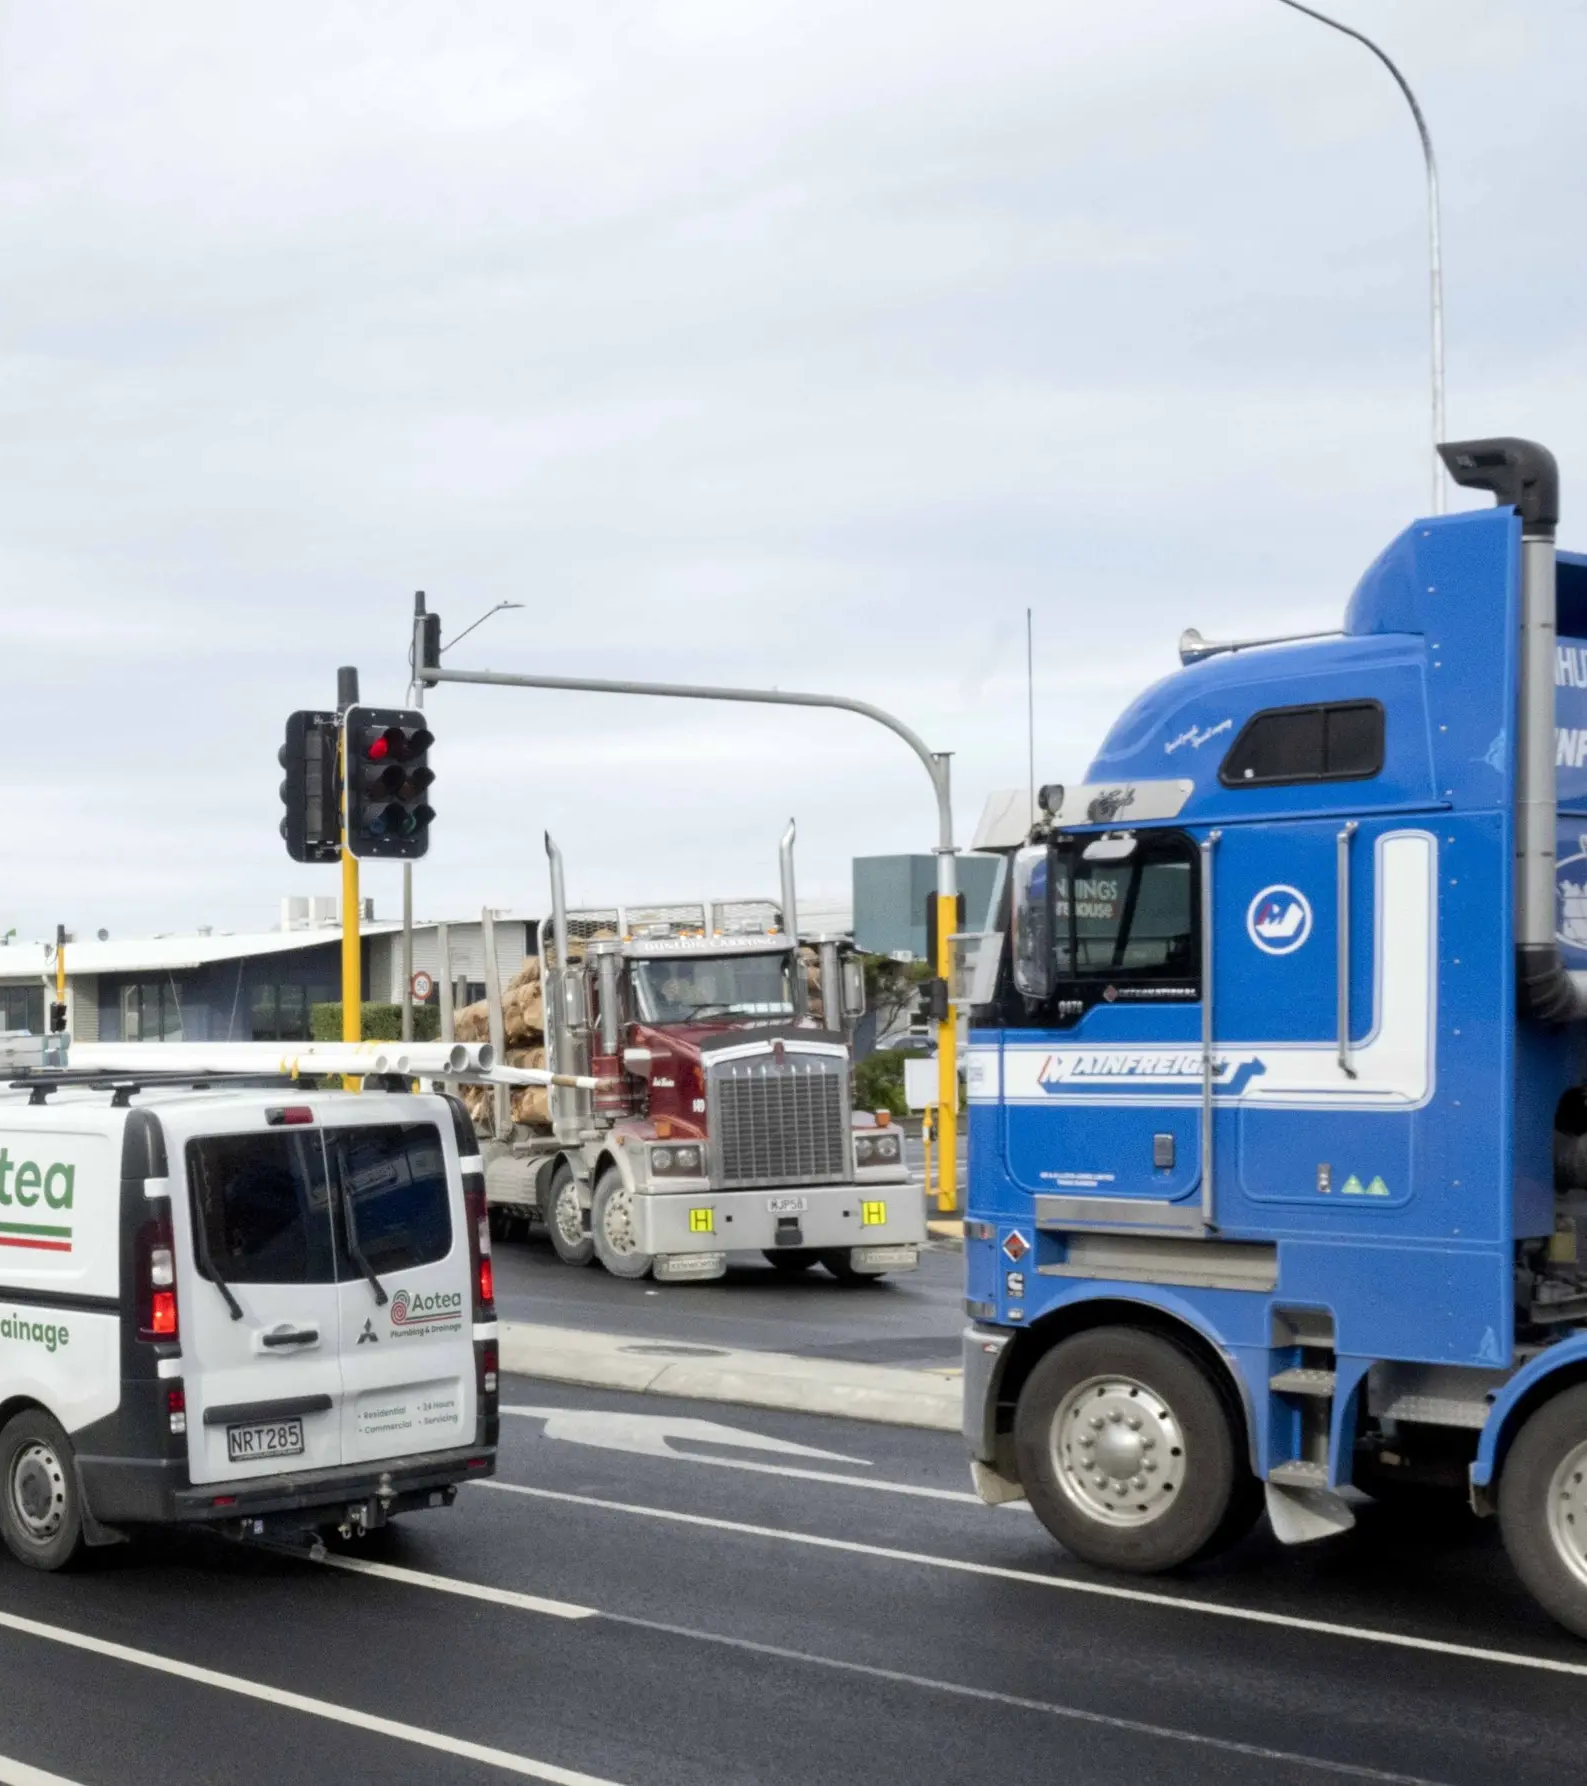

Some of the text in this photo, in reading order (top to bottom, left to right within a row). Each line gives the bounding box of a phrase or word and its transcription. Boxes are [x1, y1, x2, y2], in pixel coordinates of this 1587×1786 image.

[1055, 878, 1118, 900] NINGS
[694, 1210, 709, 1231] H
[867, 1203, 882, 1224] H
[411, 1292, 461, 1312] Aotea
[390, 1327, 424, 1338] Plumbing
[431, 1323, 462, 1333] Drainage
[363, 1405, 407, 1420] Residential
[433, 1400, 455, 1410] Hours
[363, 1419, 412, 1435] Commercial
[423, 1413, 458, 1425] Servicing
[231, 1424, 300, 1454] NRT285
